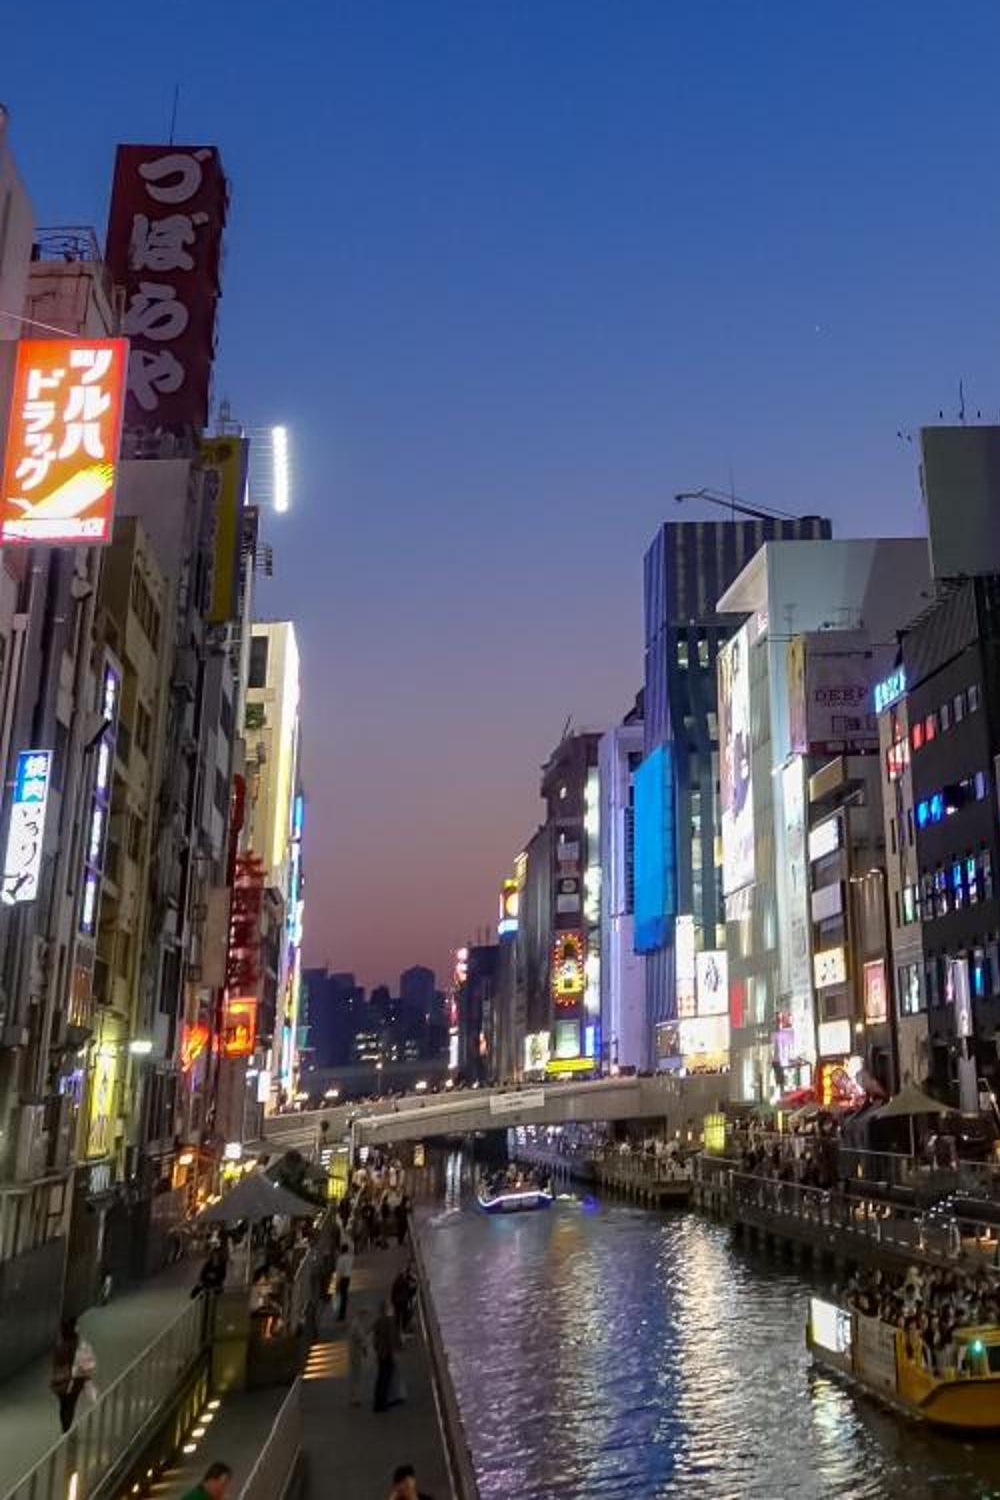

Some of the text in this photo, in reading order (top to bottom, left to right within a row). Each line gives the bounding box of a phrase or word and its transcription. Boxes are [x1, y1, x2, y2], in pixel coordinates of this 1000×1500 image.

[15, 368, 67, 492] ドラッグ
[58, 349, 113, 460] ツルハ
